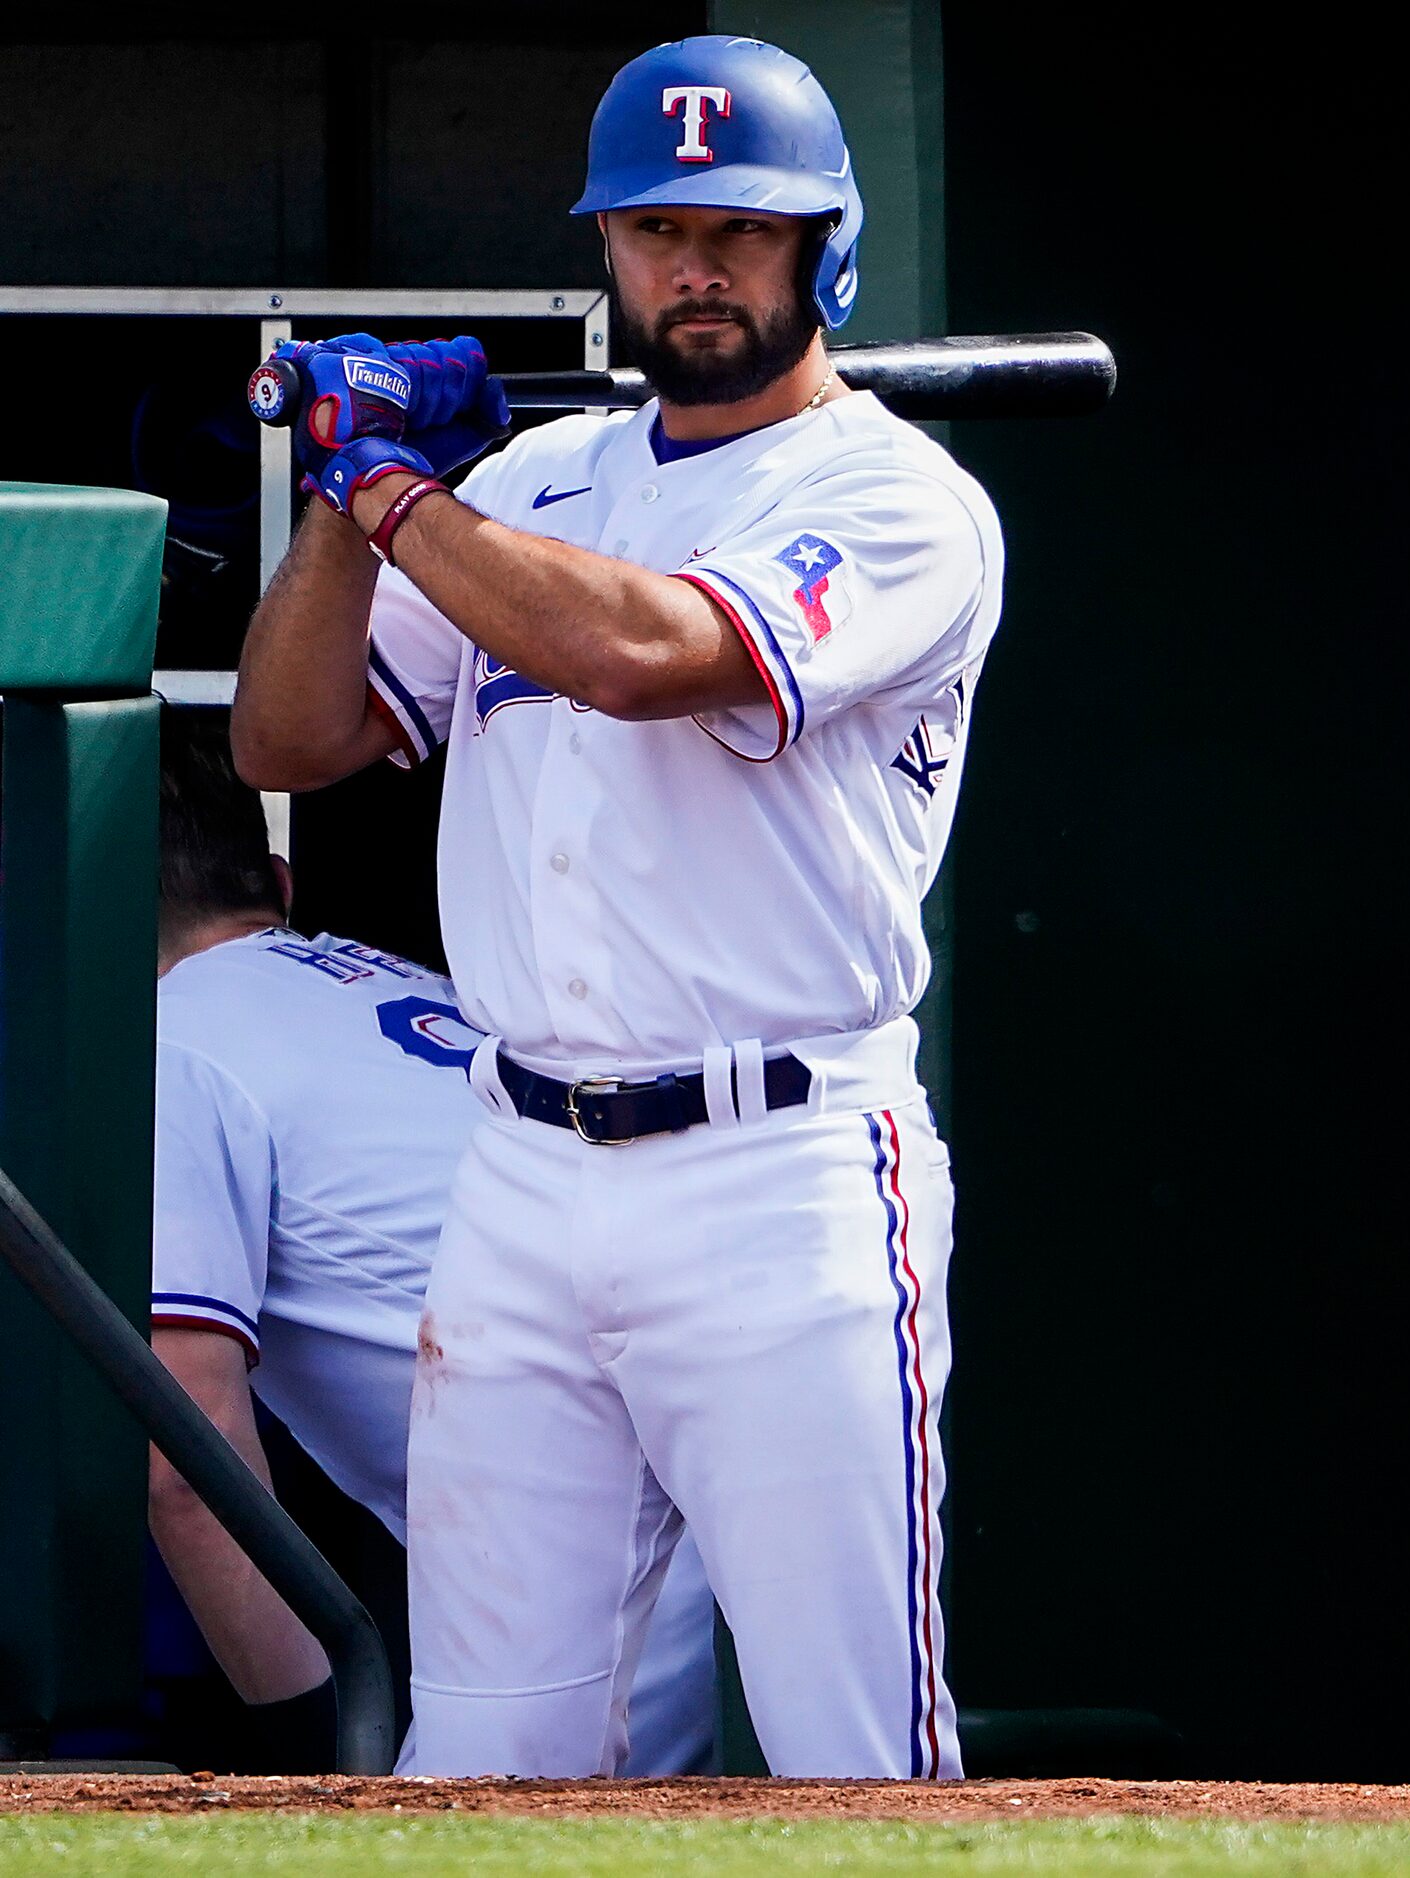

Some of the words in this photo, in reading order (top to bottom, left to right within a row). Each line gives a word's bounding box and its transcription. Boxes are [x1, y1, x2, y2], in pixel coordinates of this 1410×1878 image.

[663, 86, 731, 163] T
[261, 384, 272, 402] 9
[352, 361, 408, 400] Franklin
[334, 470, 344, 483] 9
